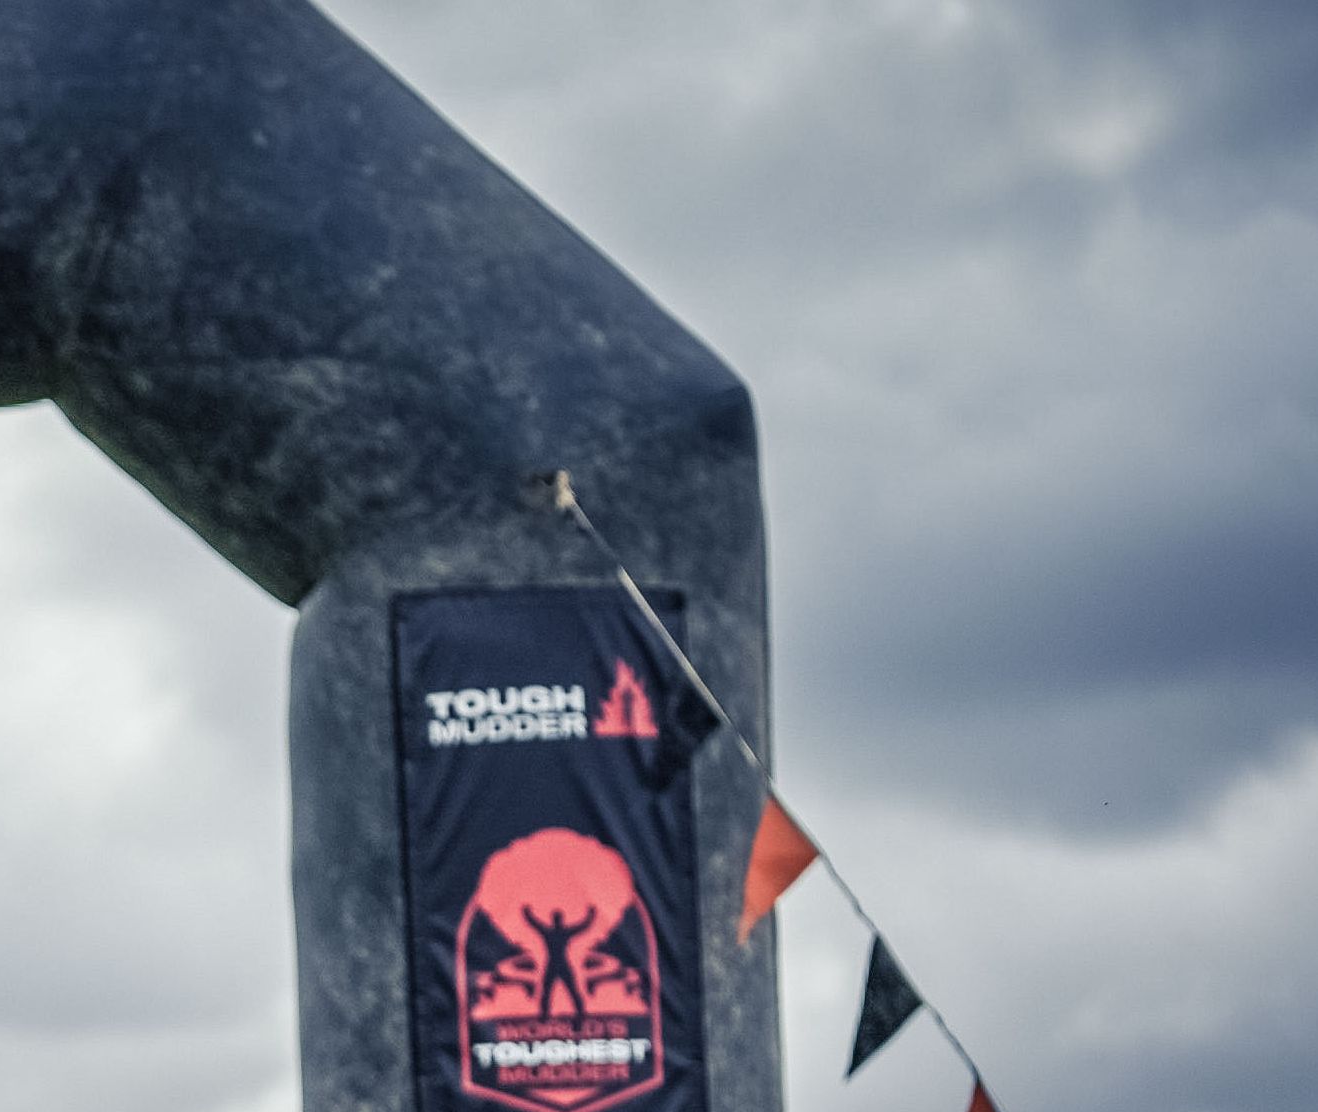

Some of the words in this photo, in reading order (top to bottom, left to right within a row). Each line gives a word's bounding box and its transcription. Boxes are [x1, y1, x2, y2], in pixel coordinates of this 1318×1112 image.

[425, 684, 586, 720] TOUGH
[428, 712, 588, 748] MUDDER
[472, 1038, 652, 1069] TOUGHEST
